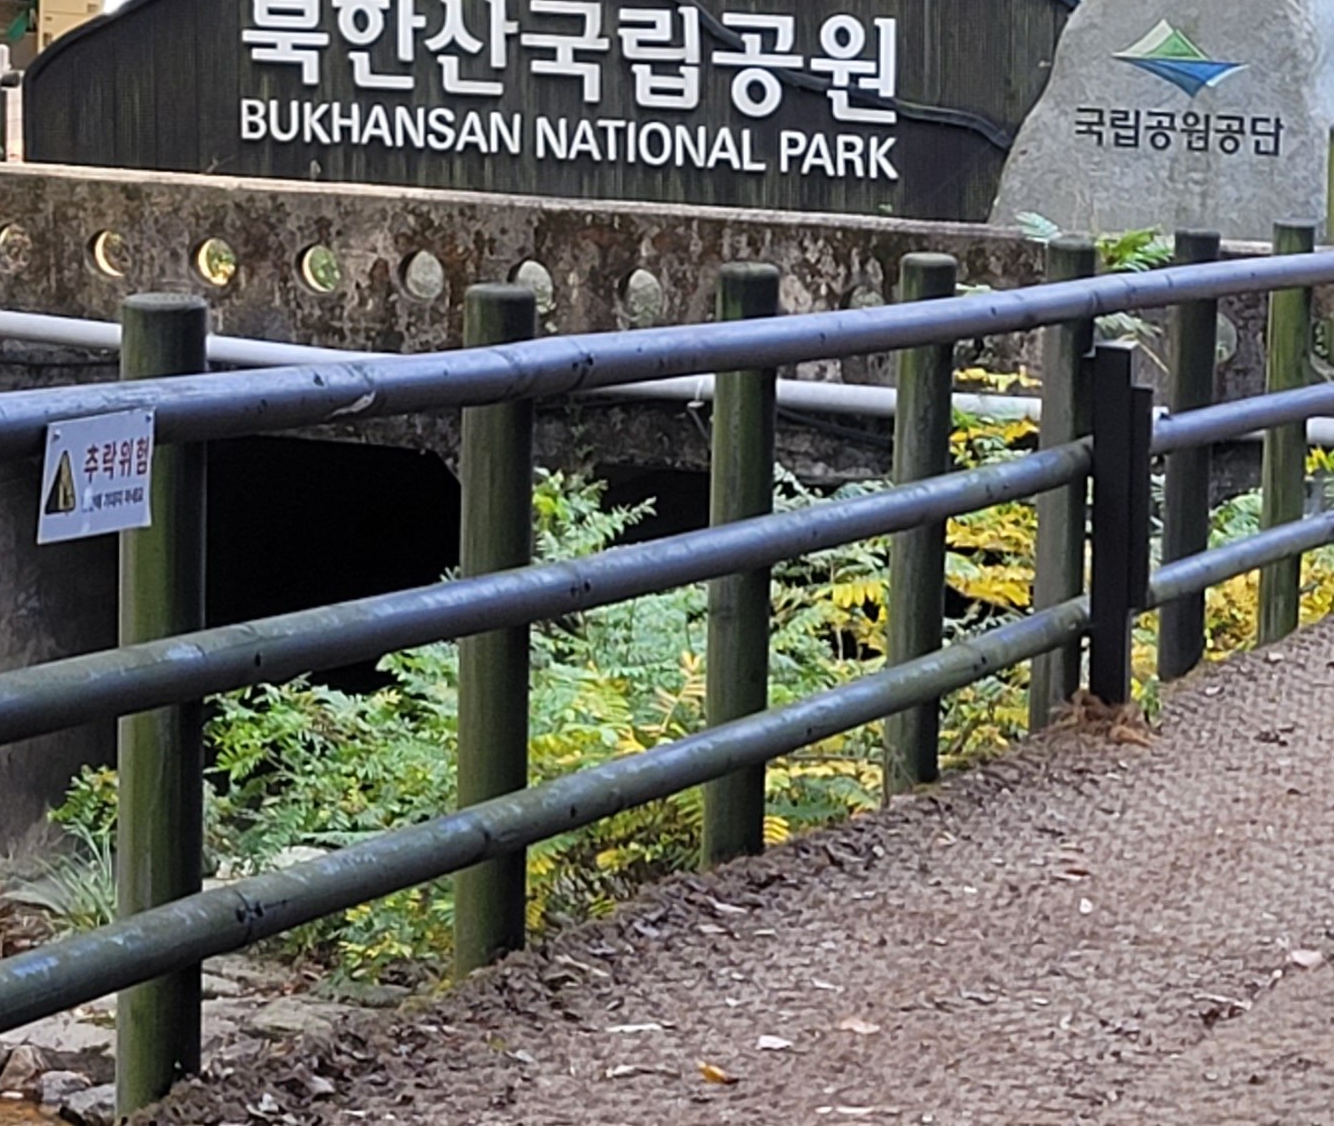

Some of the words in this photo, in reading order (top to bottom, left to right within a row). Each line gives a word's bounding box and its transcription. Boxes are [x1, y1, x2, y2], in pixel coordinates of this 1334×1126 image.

[241, 98, 522, 156] BUKHANSAN
[535, 116, 766, 173] NATIONAL
[779, 129, 899, 180] PARK
[1074, 106, 1285, 157] 국립공원공단
[84, 436, 150, 483] 추락위험
